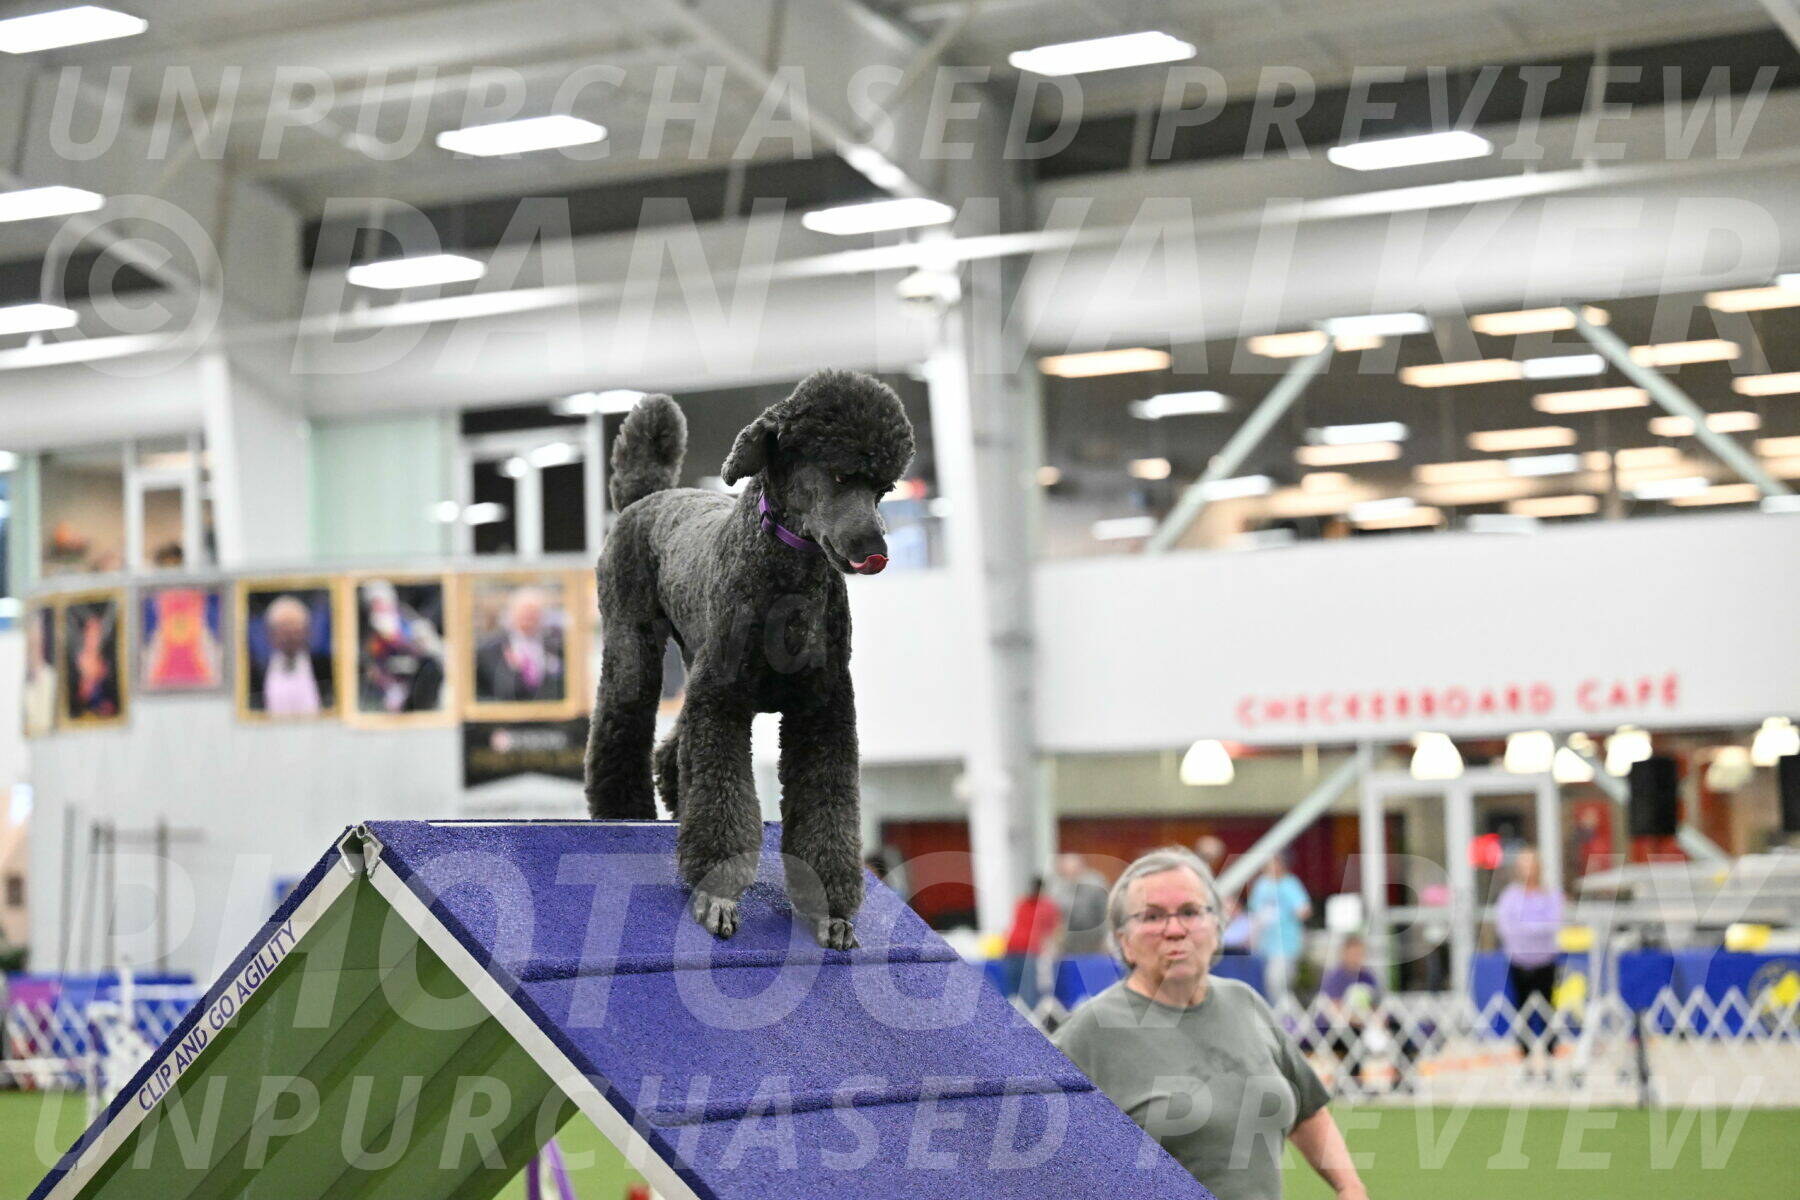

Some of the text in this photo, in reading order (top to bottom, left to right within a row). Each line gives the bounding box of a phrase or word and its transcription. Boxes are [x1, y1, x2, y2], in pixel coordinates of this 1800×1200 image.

[1237, 670, 1681, 728] CHECKERBOARD CAFÉ
[138, 920, 296, 1111] CLIP AND GO AGILITY
